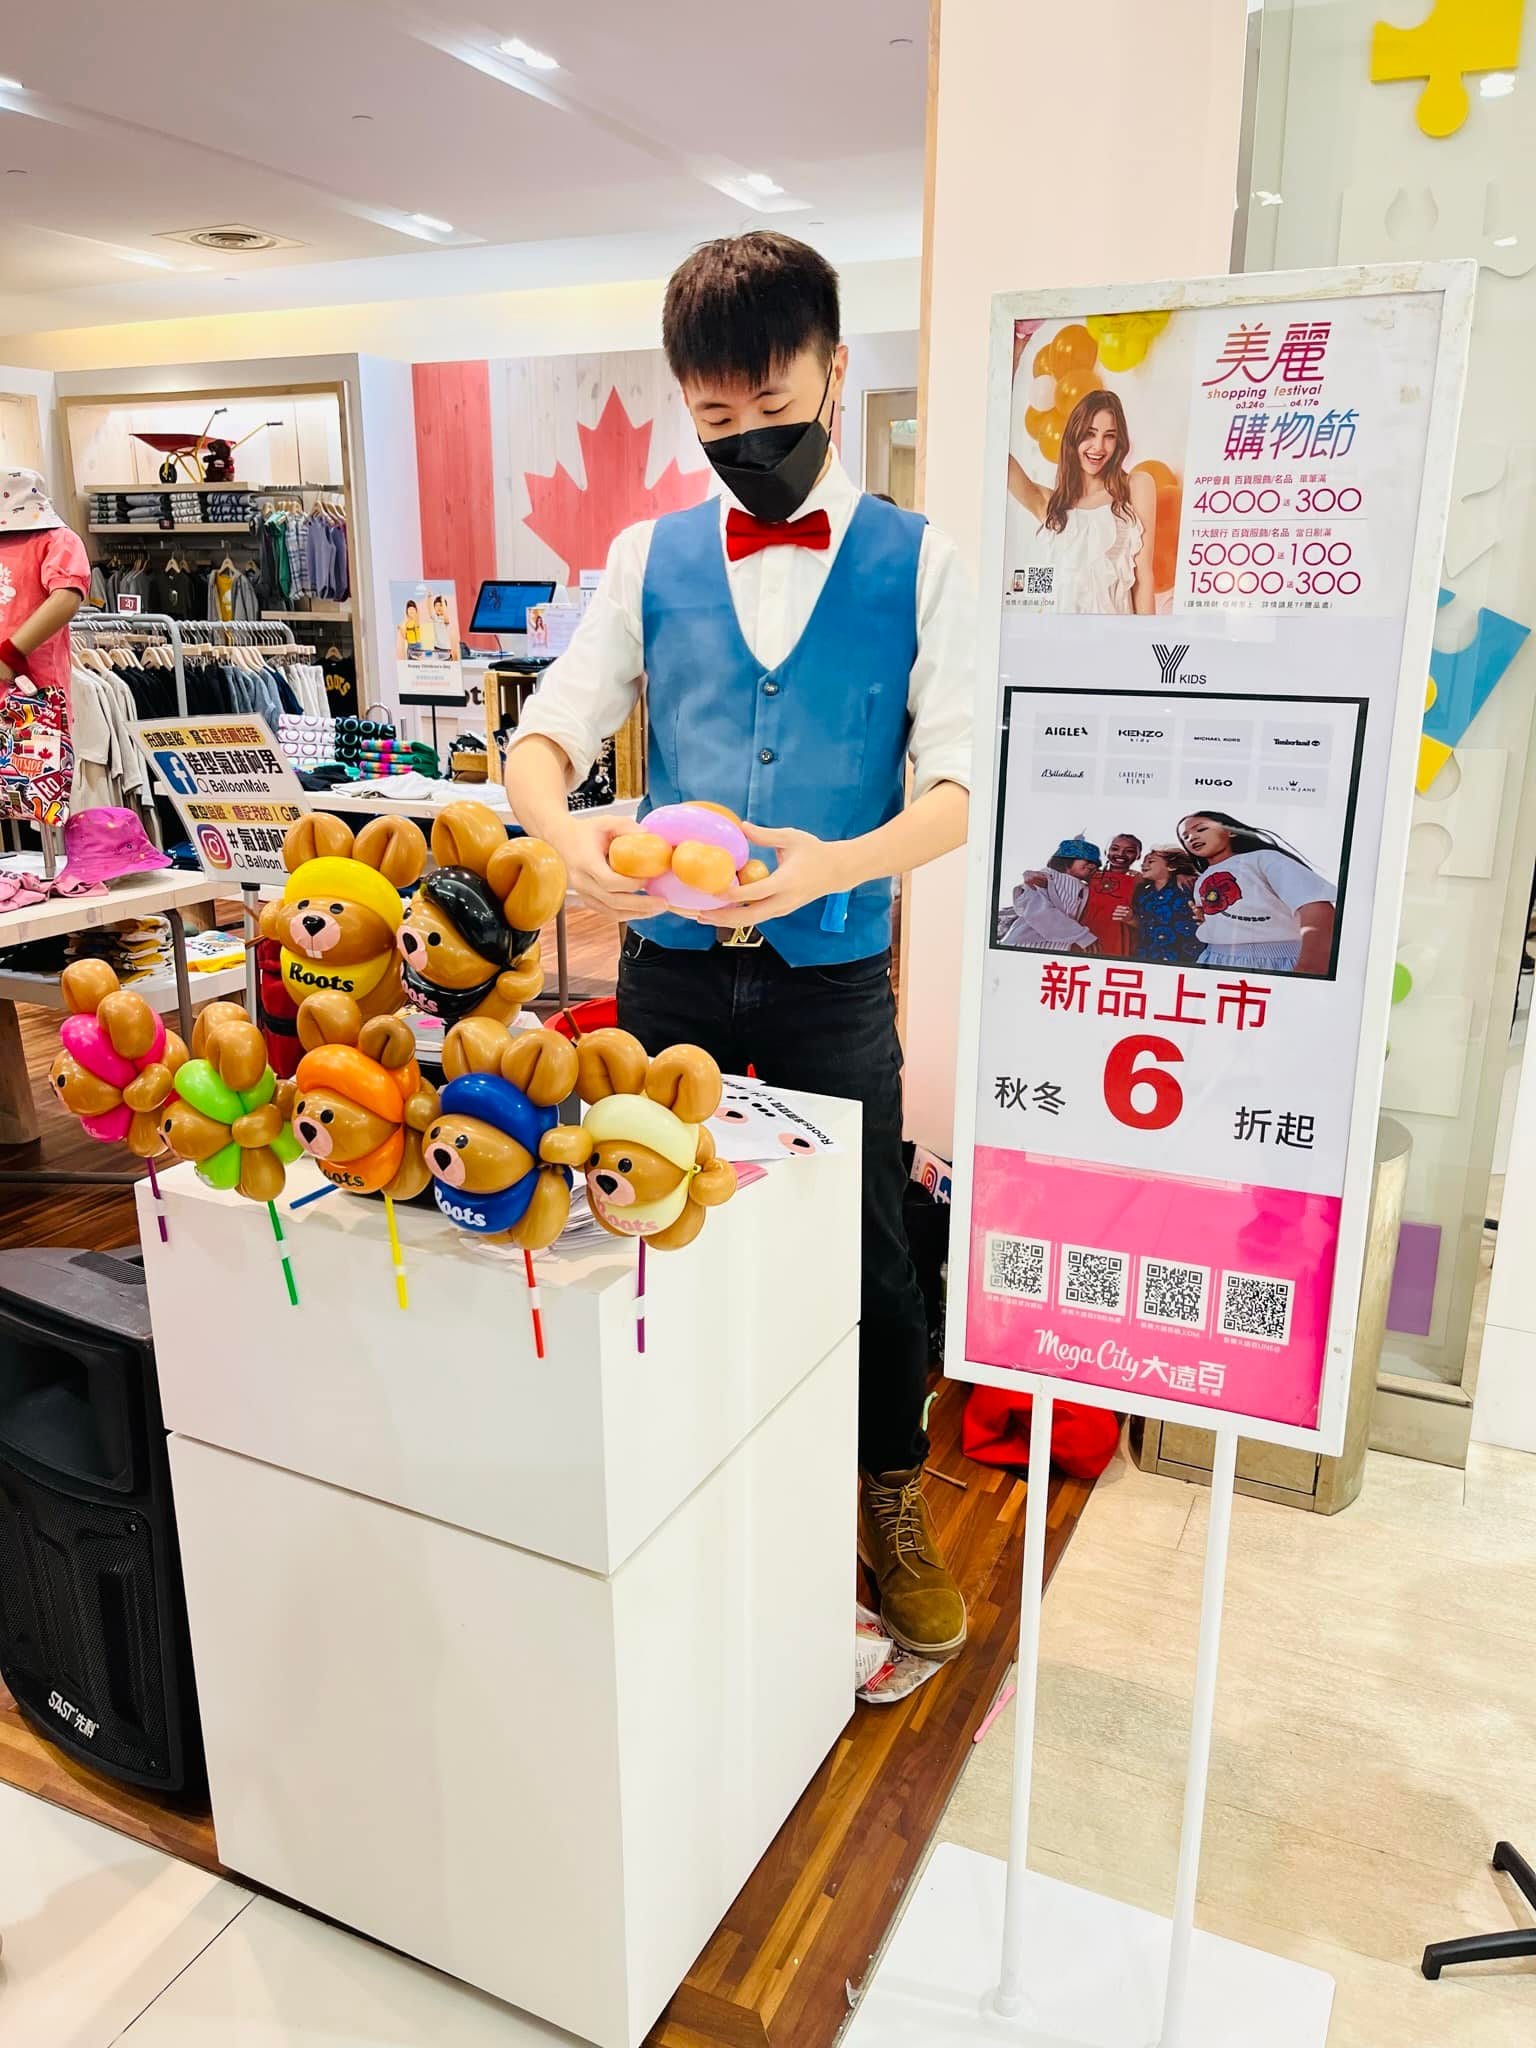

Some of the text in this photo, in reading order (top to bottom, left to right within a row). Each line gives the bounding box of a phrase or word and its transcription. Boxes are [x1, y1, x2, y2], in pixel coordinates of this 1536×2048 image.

[1202, 321, 1332, 386] 美麗
[1207, 384, 1322, 401] shopping festival
[1224, 408, 1360, 461] 購物節
[1193, 489, 1281, 514] 4000
[1295, 487, 1362, 513] 300
[1188, 542, 1275, 567] 5000
[1290, 542, 1352, 566] 100
[1189, 570, 1284, 595] 15000
[1295, 570, 1361, 595] 300
[1179, 673, 1207, 685] KIDS
[1044, 726, 1080, 737] AIGLE
[1118, 729, 1164, 738] KENZO
[210, 778, 271, 794] BalloonMale
[1194, 778, 1233, 787] HUGO
[289, 962, 354, 993] Roots
[1040, 960, 1272, 1031] 新品上市
[1103, 1033, 1185, 1131] 6
[994, 1075, 1316, 1150] 秋冬 折起
[1033, 1329, 1095, 1371] Mega
[1096, 1340, 1142, 1382] City
[1141, 1356, 1228, 1392] 大遠百
